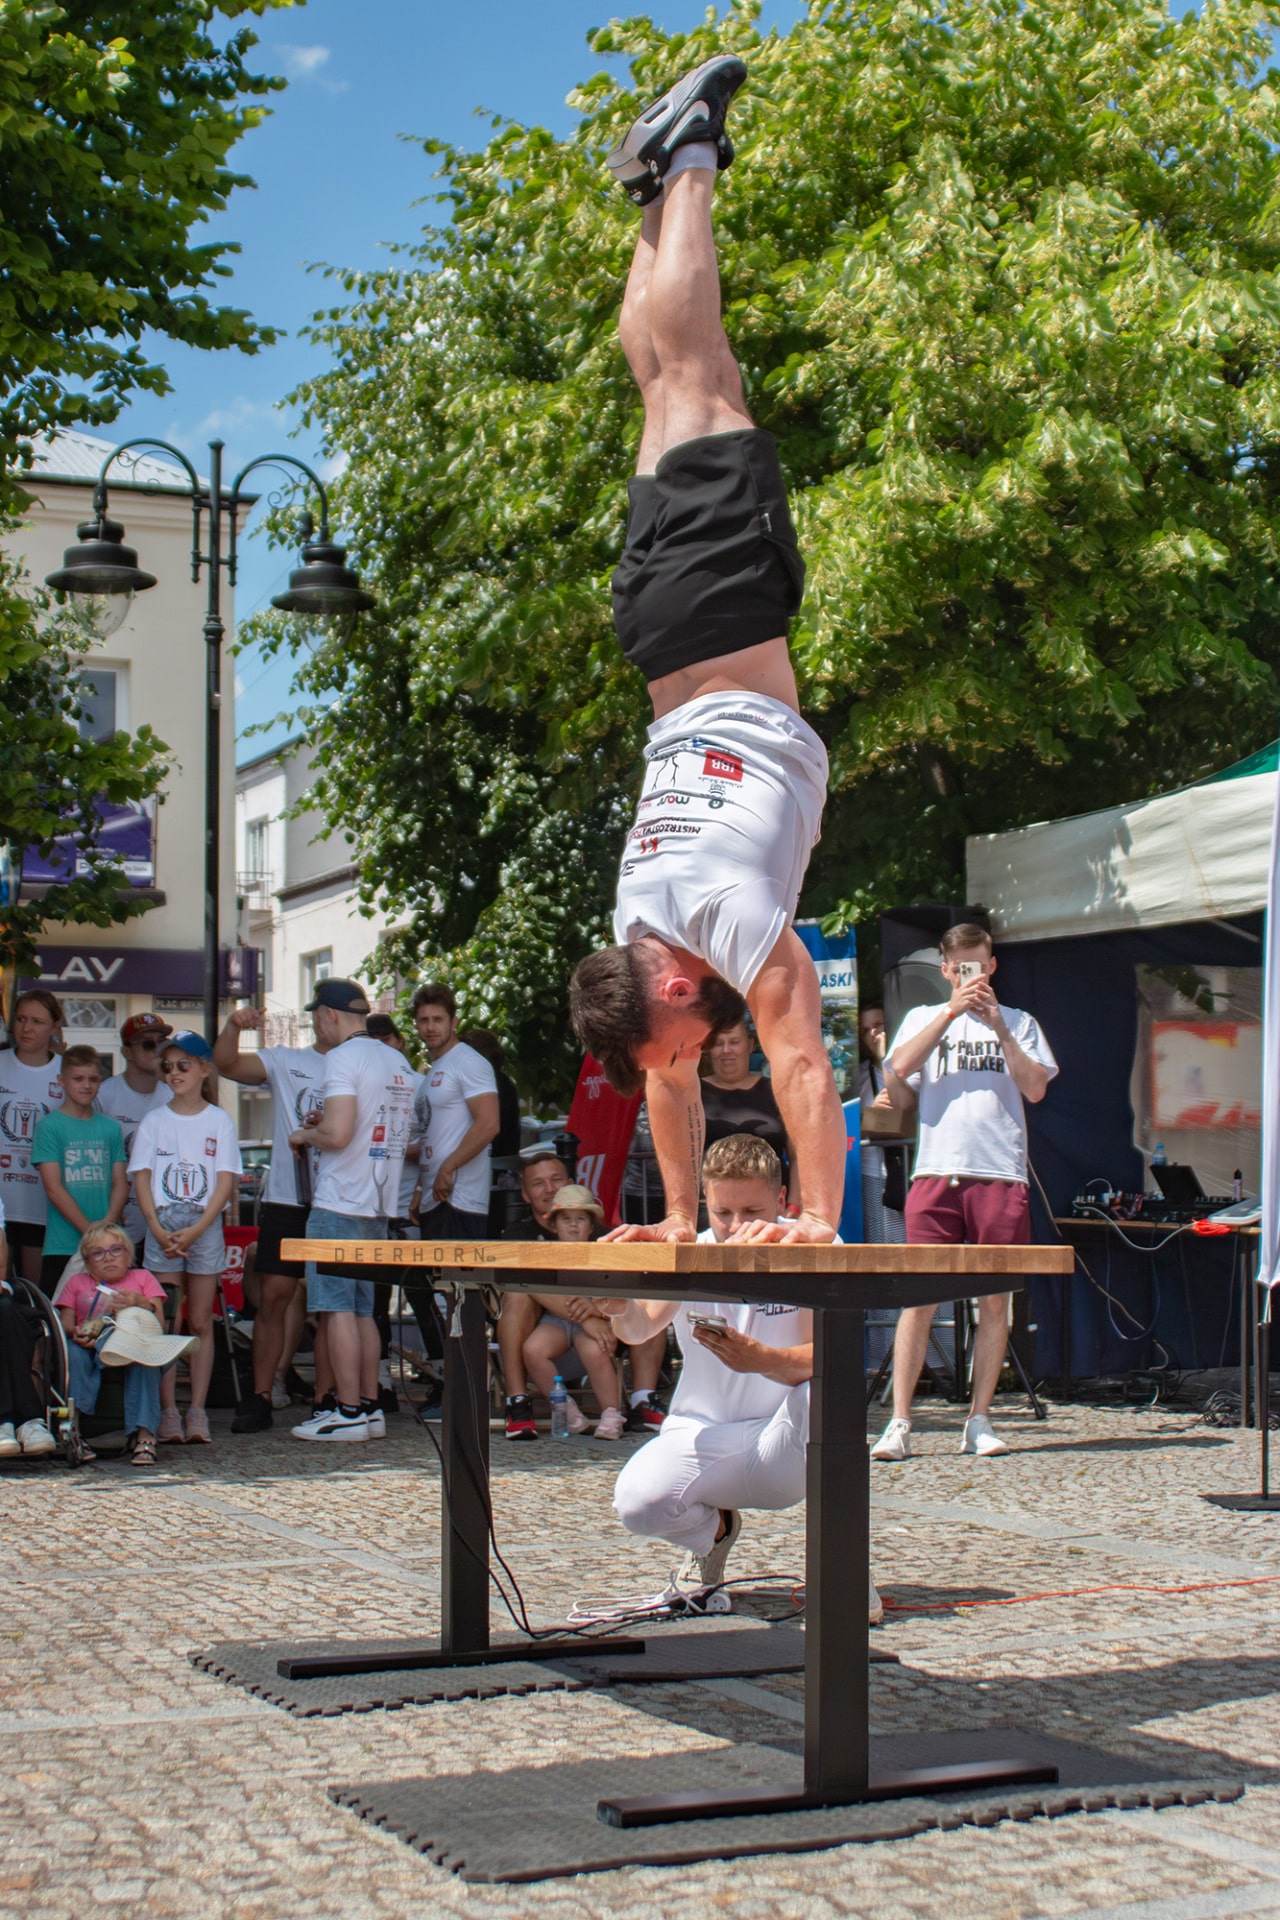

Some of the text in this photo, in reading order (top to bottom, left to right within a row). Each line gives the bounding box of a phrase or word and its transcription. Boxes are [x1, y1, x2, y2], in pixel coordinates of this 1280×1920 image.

[33, 955, 125, 982] LAY
[820, 971, 852, 989] ASKI
[957, 1039, 1002, 1057] PARTY
[957, 1054, 1005, 1073] MAKER
[334, 1247, 485, 1264] DEERHORN
